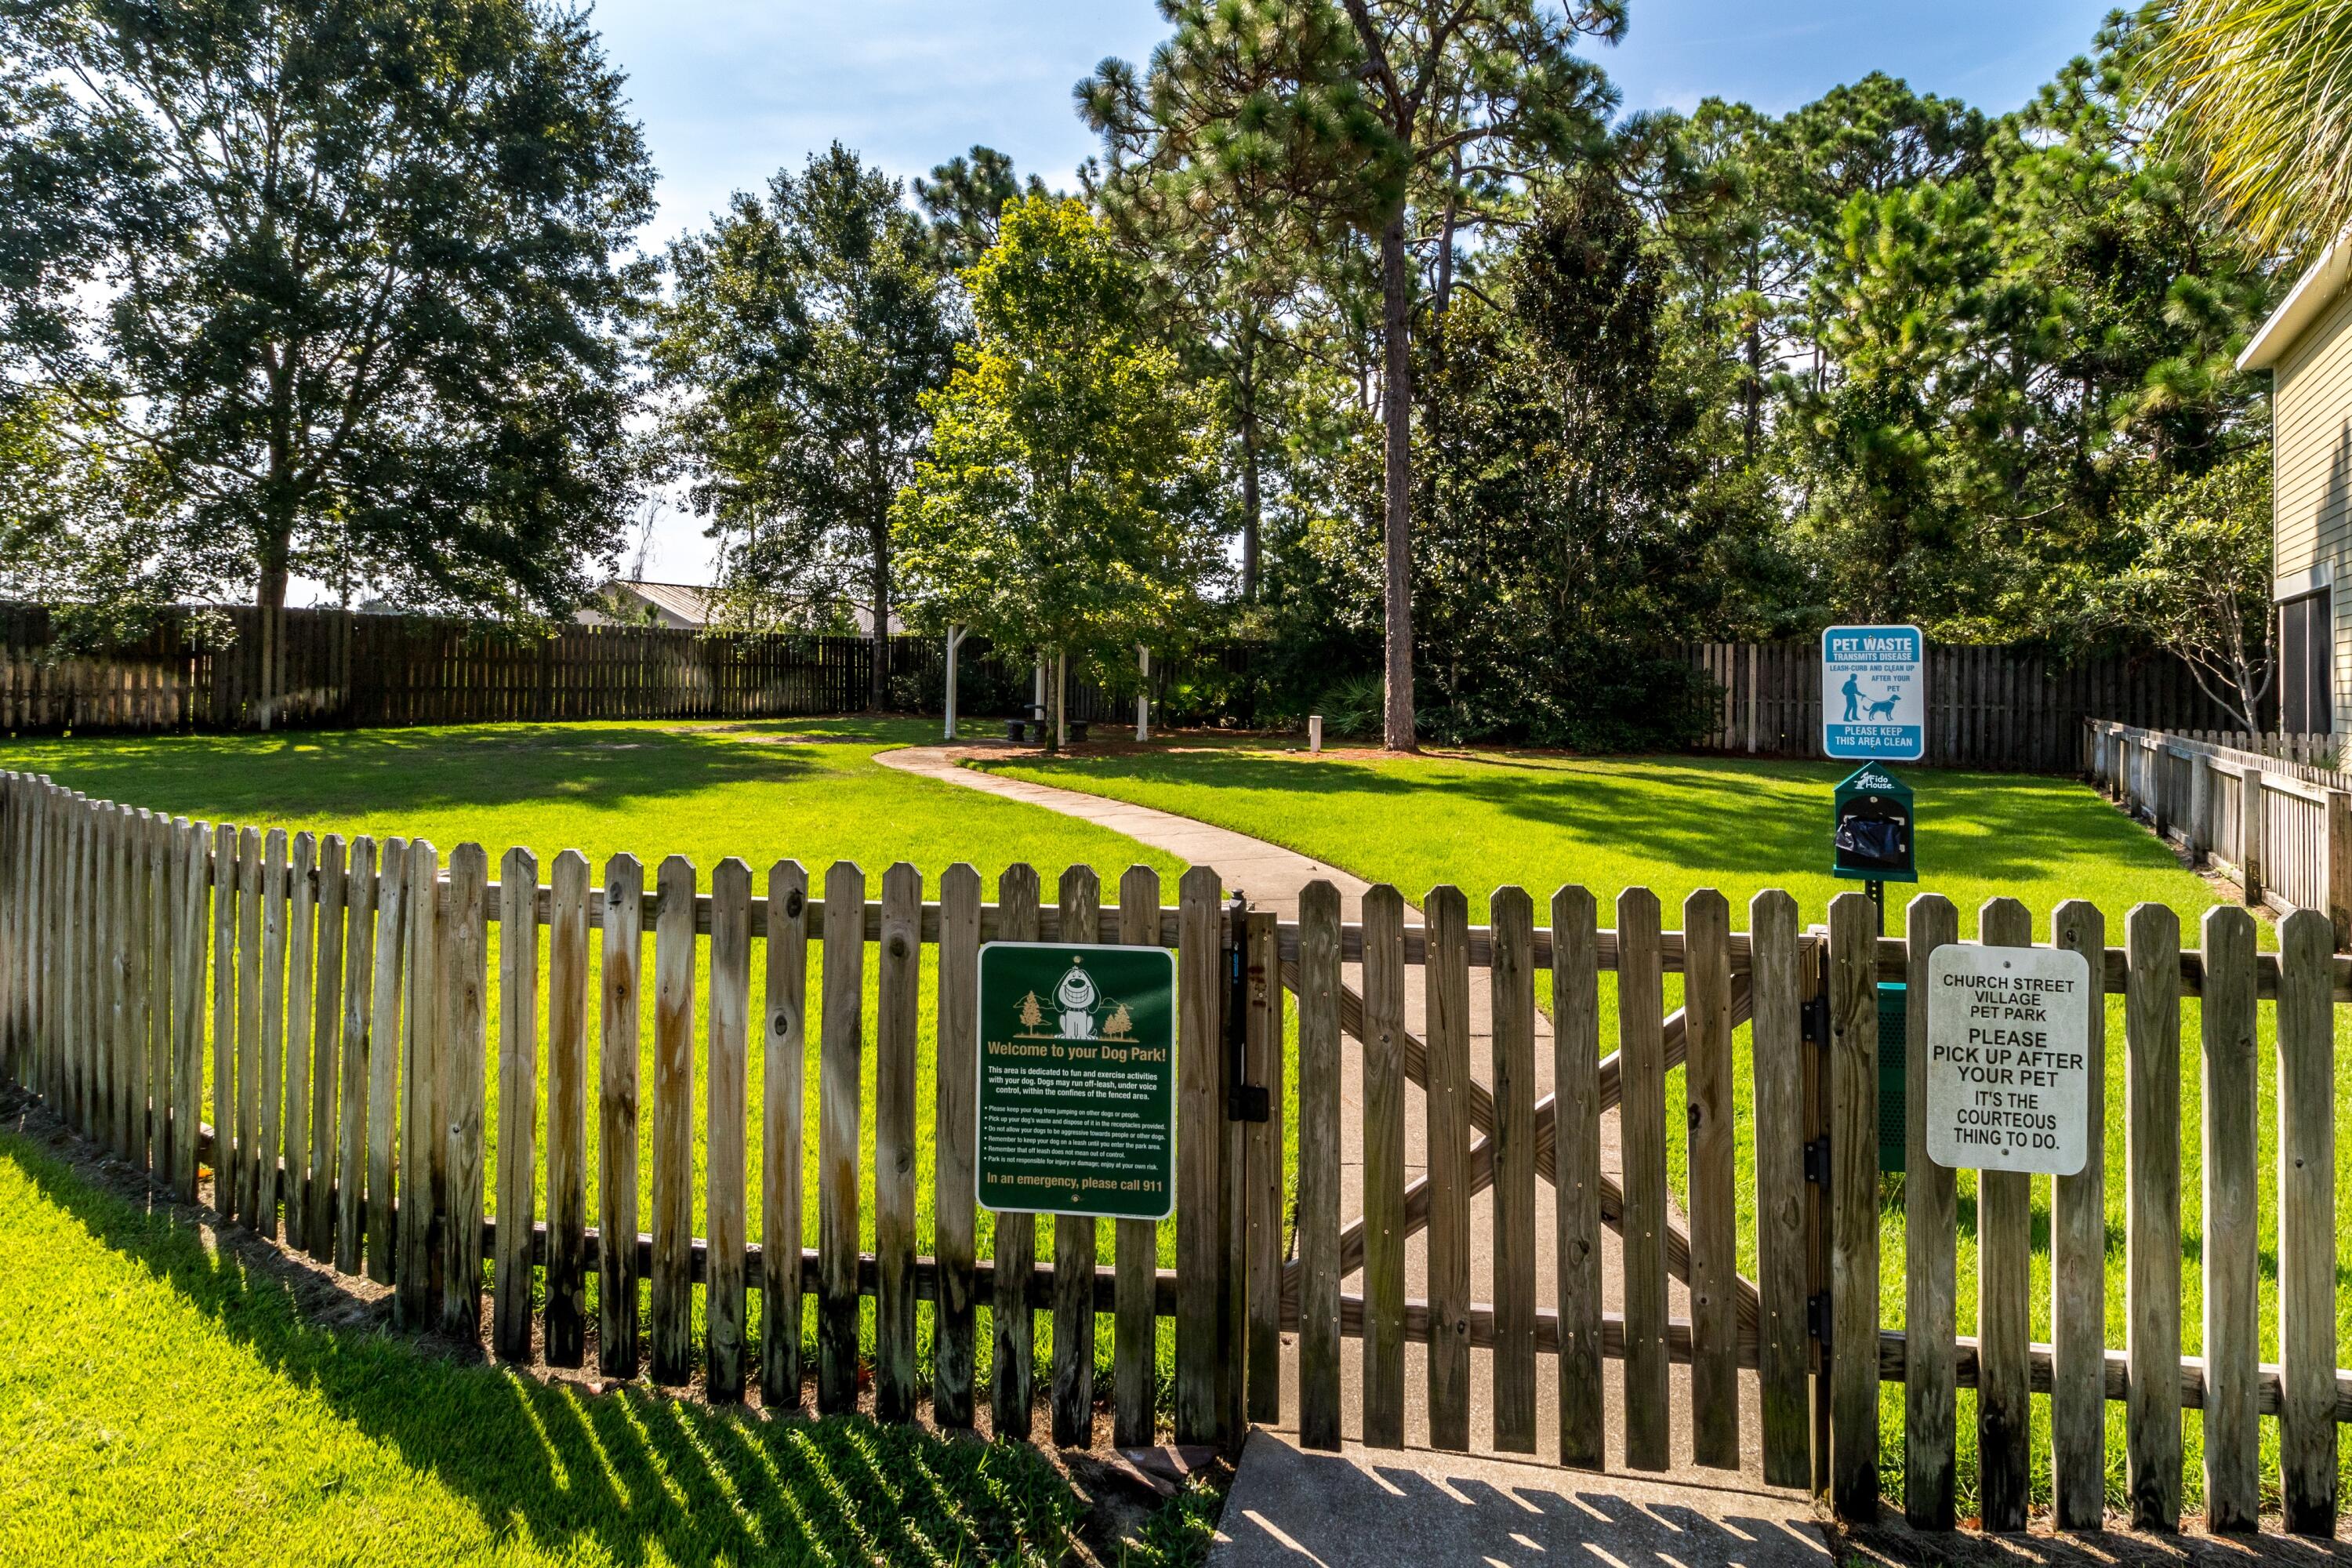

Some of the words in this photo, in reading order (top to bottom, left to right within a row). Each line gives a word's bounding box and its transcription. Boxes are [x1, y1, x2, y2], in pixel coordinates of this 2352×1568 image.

[1833, 638, 1858, 651] PET
[1864, 638, 1911, 651] WASTE
[1846, 727, 1877, 735] PLEASE
[1858, 737, 1881, 746] AREA
[1884, 738, 1912, 746] CLEAN
[1944, 974, 2008, 989] CHURCH
[2013, 978, 2074, 993] STREET
[1975, 991, 2041, 1006] VILLAGE
[1971, 1006, 1999, 1019] PET
[2005, 1007, 2046, 1022] PARK
[1969, 1029, 2047, 1047] PLEASE
[987, 1041, 1047, 1056] Welcome
[1051, 1044, 1064, 1057] to
[1068, 1047, 1098, 1060] your
[1101, 1045, 1127, 1062] Dog
[1131, 1047, 1166, 1062] Park!
[1933, 1046, 1979, 1063] PICK
[1986, 1049, 2011, 1065] UP
[2017, 1051, 2083, 1069] AFTER
[1021, 1076, 1036, 1086] dog.
[1037, 1077, 1054, 1087] Dogs
[1084, 1080, 1116, 1089] off-leash,
[1027, 1067, 1061, 1076] dedicated
[1127, 1072, 1157, 1080] activities
[1958, 1066, 2013, 1084] YOUR
[2020, 1071, 2058, 1087] PET
[995, 1086, 1021, 1094] control,
[1975, 1091, 2002, 1107] IT'S
[2008, 1093, 2038, 1109] THE
[1958, 1109, 2056, 1129] COURTEOUS
[1954, 1127, 2001, 1145] THING
[2006, 1131, 2027, 1146] TO
[2033, 1134, 2060, 1150] DO.
[987, 1171, 997, 1183] In
[1000, 1174, 1014, 1184] an
[1016, 1175, 1079, 1189] emergency,
[1081, 1176, 1117, 1189] please
[1120, 1179, 1140, 1190] call
[1142, 1180, 1162, 1192] 911
